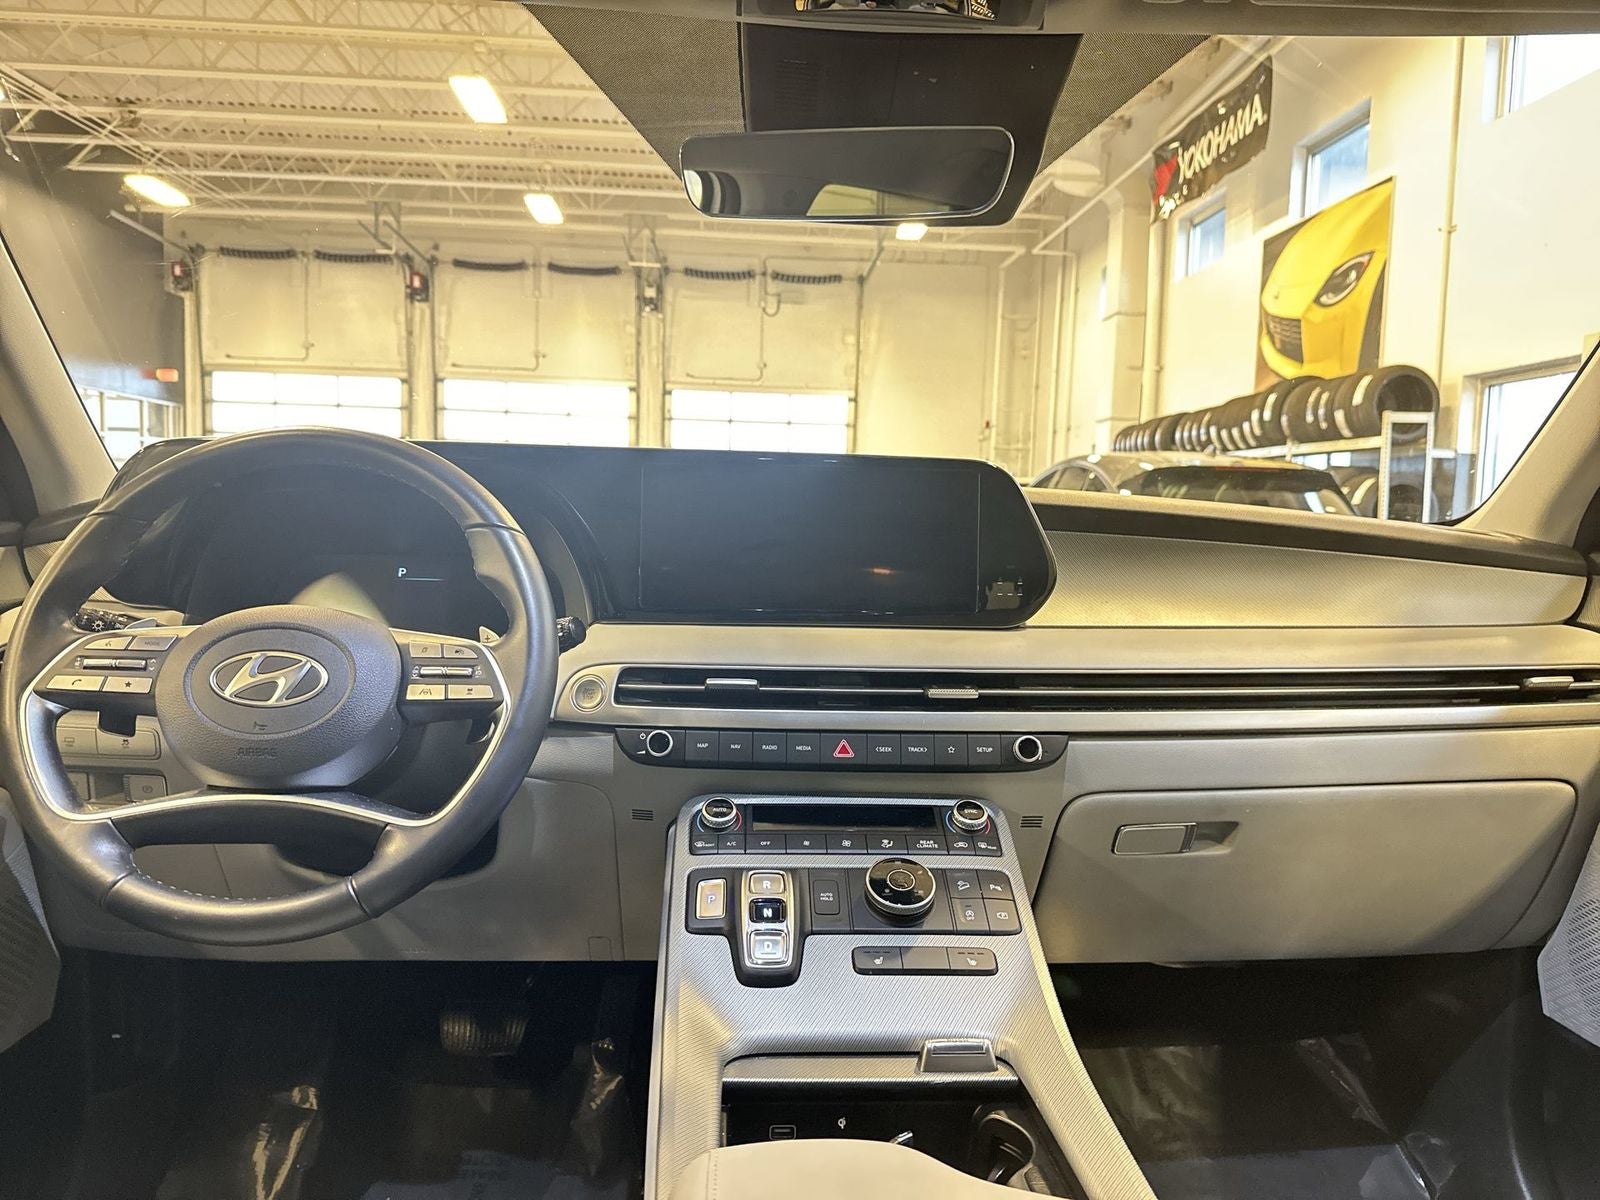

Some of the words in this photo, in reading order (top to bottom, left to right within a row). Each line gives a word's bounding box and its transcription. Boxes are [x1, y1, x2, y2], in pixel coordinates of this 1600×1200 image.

[1177, 94, 1264, 184] YOKOHAMA
[398, 567, 407, 577] P
[763, 881, 771, 889] R
[706, 894, 716, 903] P
[763, 908, 773, 917] N
[764, 941, 773, 950] D
